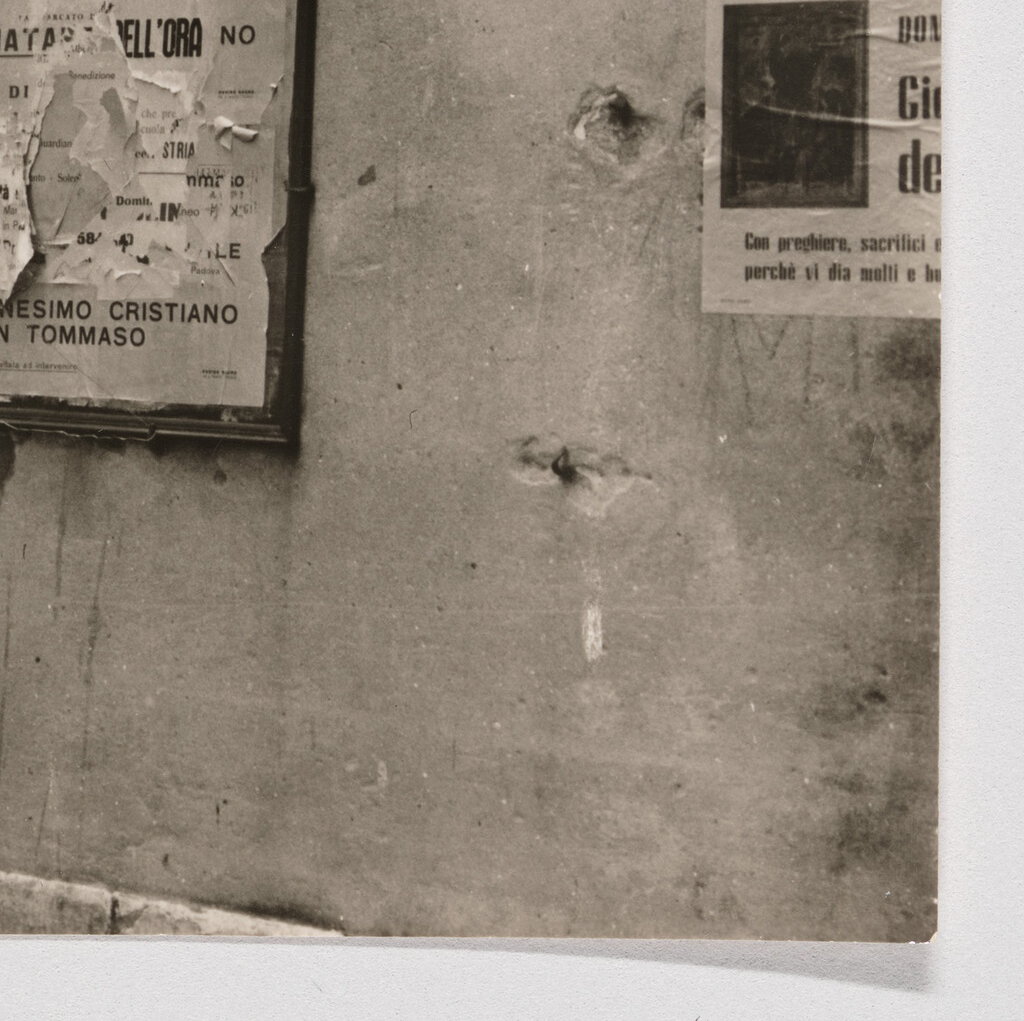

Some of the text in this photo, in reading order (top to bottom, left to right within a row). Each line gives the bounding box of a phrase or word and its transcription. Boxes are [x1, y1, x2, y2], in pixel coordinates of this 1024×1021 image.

[9, 84, 29, 99] DI
[744, 232, 770, 251] Con
[778, 232, 852, 254] preghiere,
[861, 234, 925, 253] sacrifici
[744, 261, 796, 282] perchè
[805, 262, 819, 281] vi
[828, 262, 851, 282] dia
[860, 263, 898, 283] molti
[906, 267, 916, 282] e
[108, 300, 240, 326] CRISTIANO
[25, 324, 147, 348] TOMMASO
